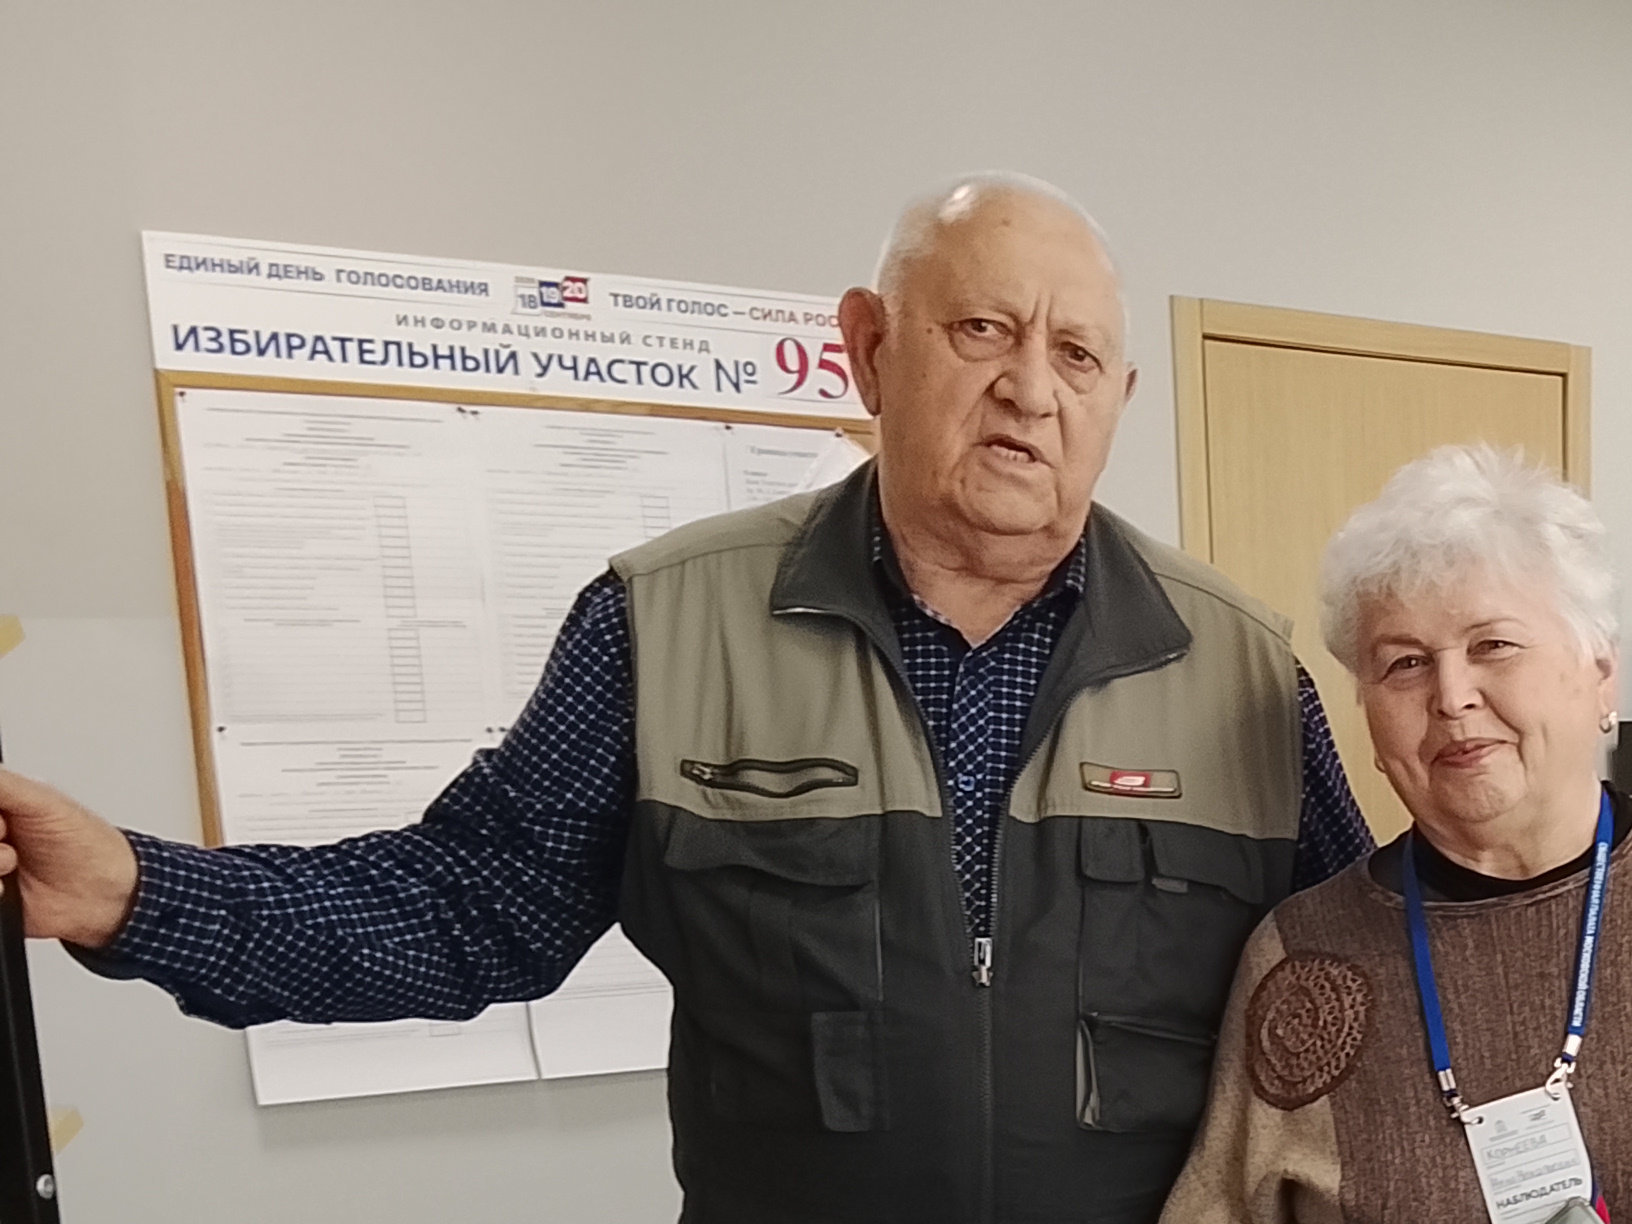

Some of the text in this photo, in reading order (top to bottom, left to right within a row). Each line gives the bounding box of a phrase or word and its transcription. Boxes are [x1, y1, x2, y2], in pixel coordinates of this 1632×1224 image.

[164, 253, 490, 297] ЕДИНЫЙ ДЕНЬ ГОЛОСОВАНИЯ
[517, 293, 539, 309] 18
[562, 280, 587, 299] 20
[609, 292, 662, 310] ТВОЙ
[666, 298, 729, 318] ГОЛОС
[749, 307, 799, 326] СИЛА
[395, 313, 633, 346] ИНФОРМАЦИОННЫЙ
[642, 334, 712, 354] СТЕНД
[172, 323, 849, 400] ИЗБИРАТЕЛЬНЫЙ УЧАСТОК № 95
[1571, 841, 1610, 1028] ОБЩЕСТВЕННАЯ ПАЛАТА МОСКОВСКОЙ ОБЛАСТИ
[1495, 1177, 1583, 1209] НАБЛЮДАТЕЛЬ
